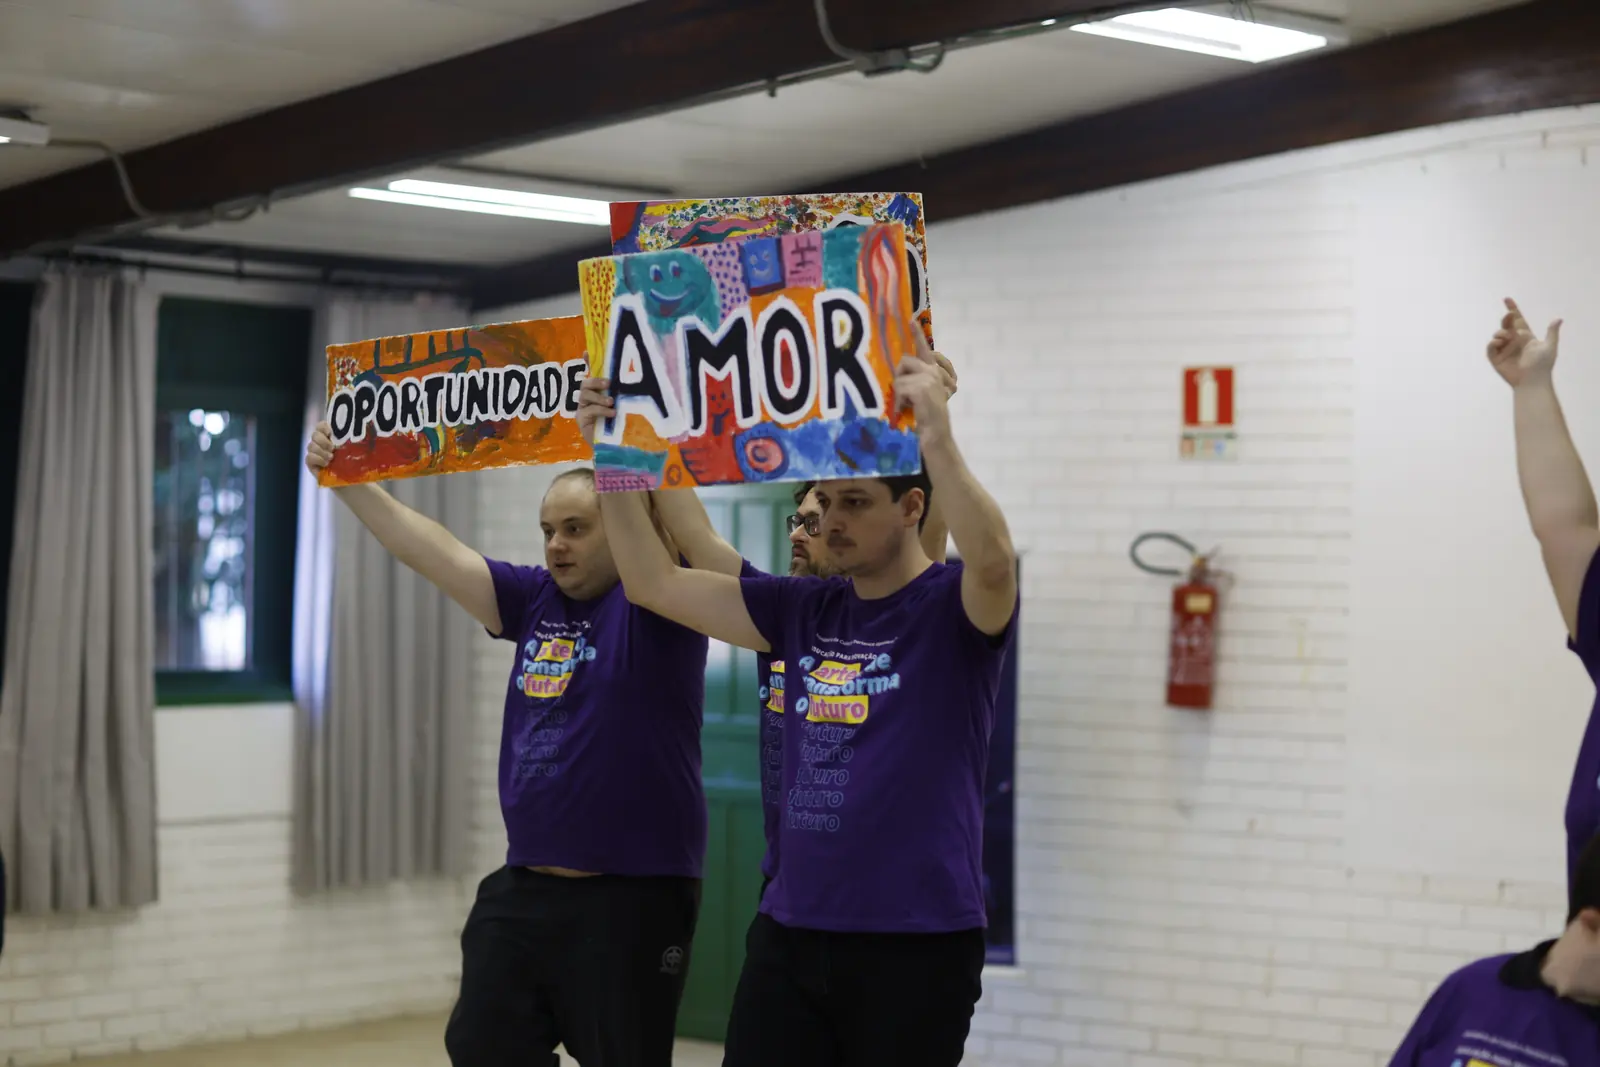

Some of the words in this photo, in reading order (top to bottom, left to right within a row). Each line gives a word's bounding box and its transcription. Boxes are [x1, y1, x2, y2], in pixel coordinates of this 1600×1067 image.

[606, 288, 889, 443] AMOR
[327, 361, 587, 445] OPORTUNIDADE
[802, 672, 901, 696] ransorma
[815, 666, 857, 681] arte
[516, 675, 524, 691] o
[525, 675, 569, 694] futur
[795, 696, 809, 713] o
